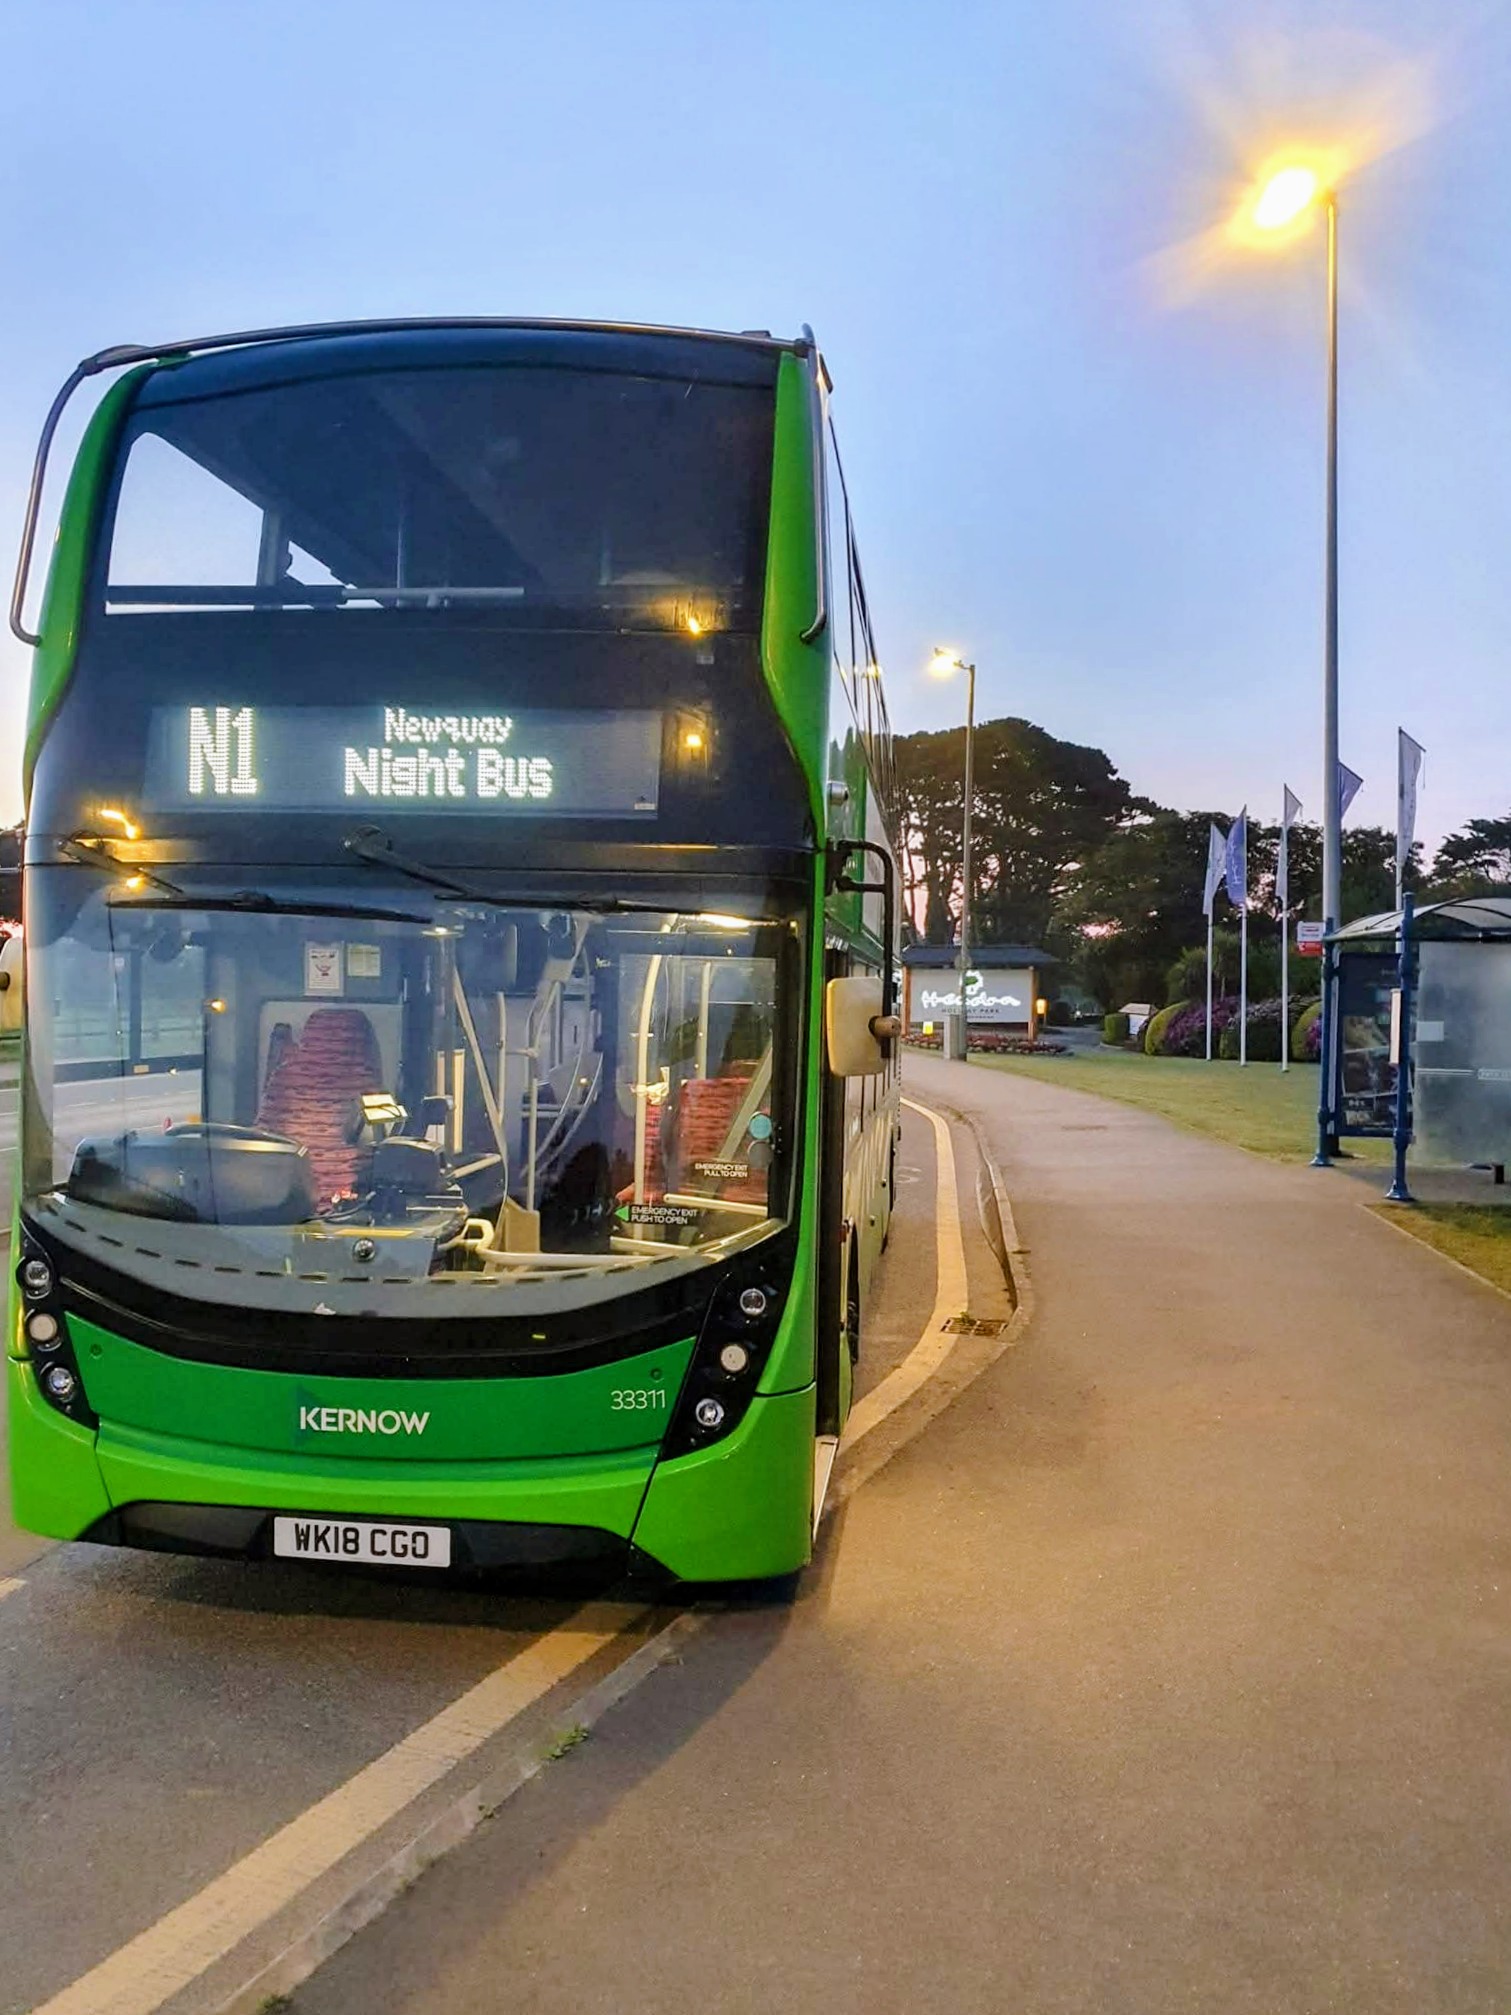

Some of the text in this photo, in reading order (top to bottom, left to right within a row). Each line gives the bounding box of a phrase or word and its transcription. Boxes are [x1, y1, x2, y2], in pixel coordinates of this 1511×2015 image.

[384, 707, 512, 743] Newquay
[188, 707, 258, 794] N1
[344, 748, 553, 798] Night Bus
[631, 1206, 697, 1217] EMERGENCY EXIT
[631, 1214, 653, 1223] PUSH
[665, 1216, 688, 1225] OPEN
[610, 1389, 666, 1410] 33311
[300, 1406, 430, 1435] KERNOW
[294, 1523, 430, 1560] WK18 CGO
